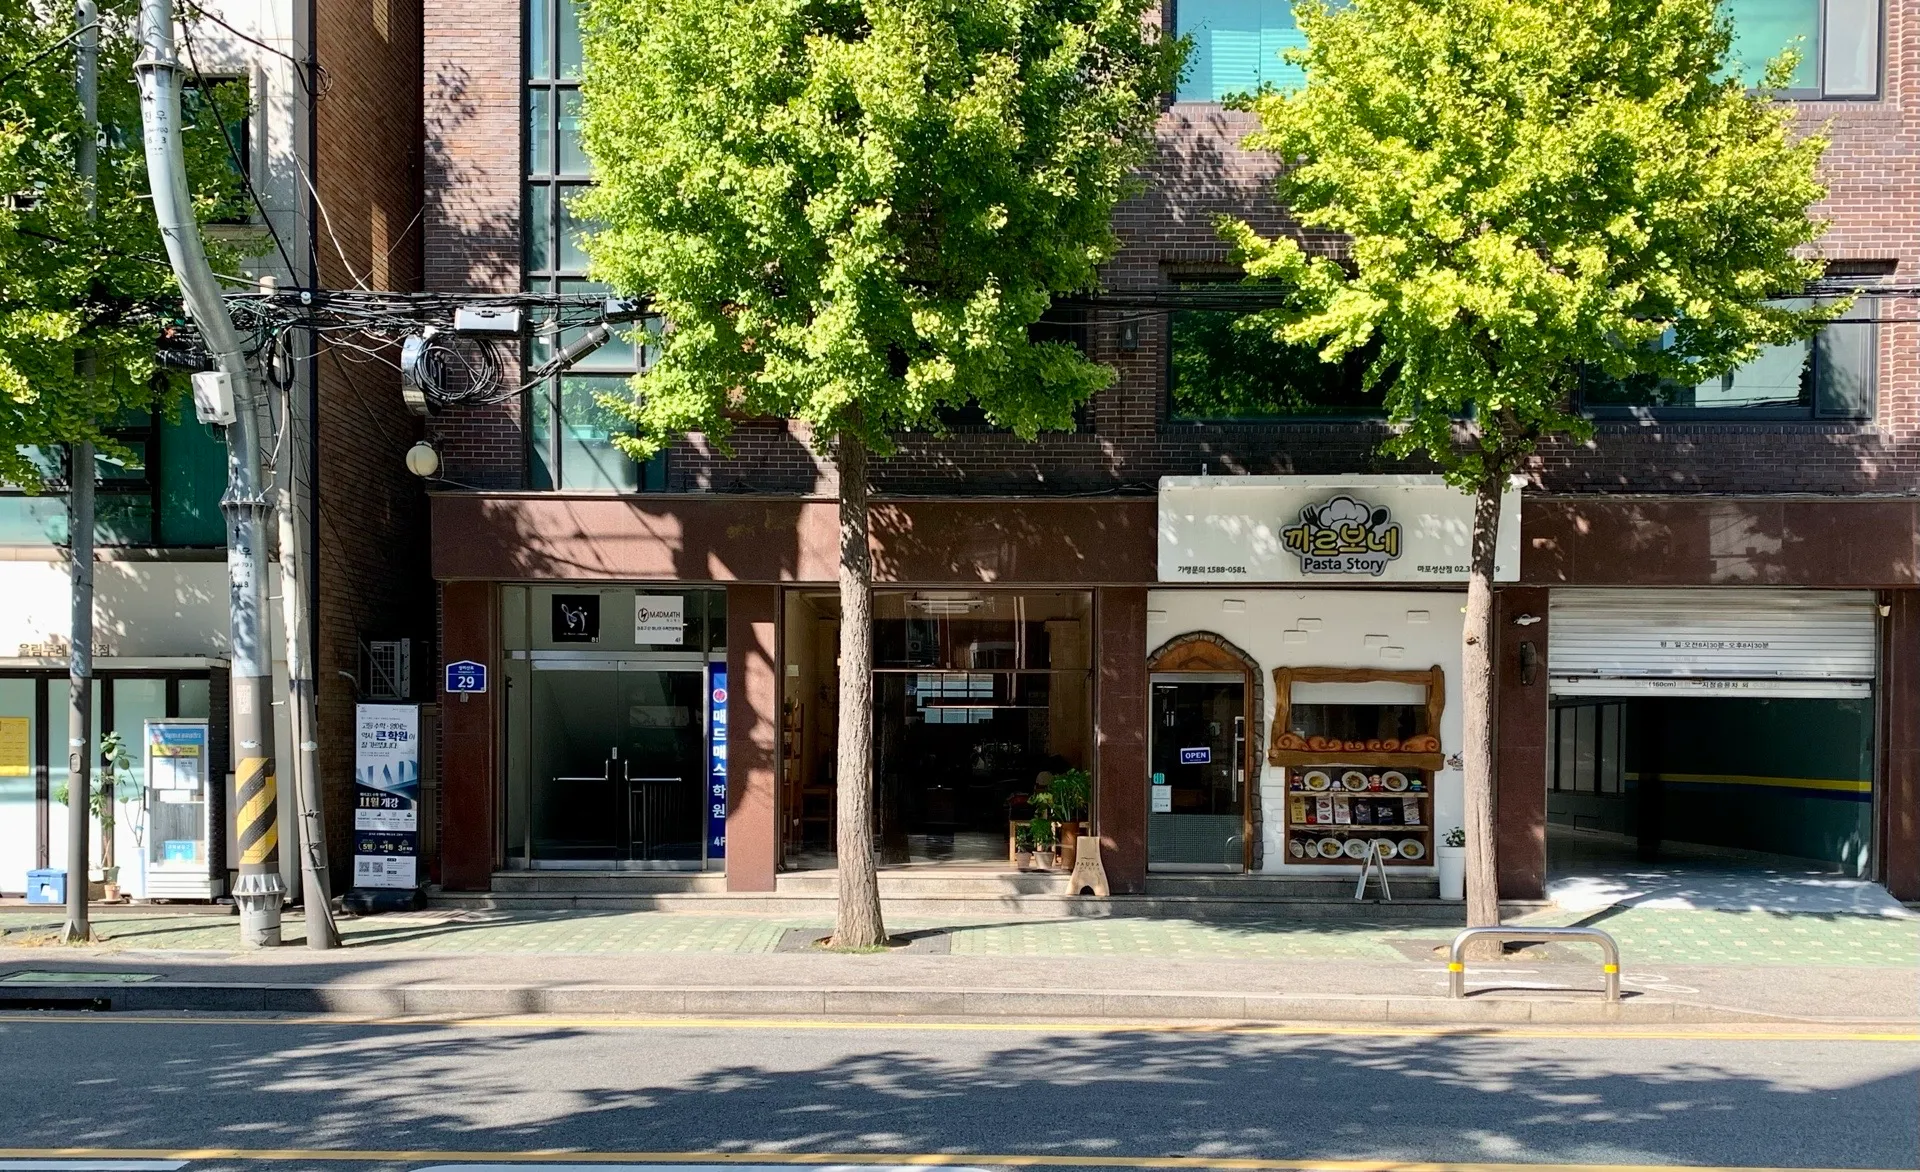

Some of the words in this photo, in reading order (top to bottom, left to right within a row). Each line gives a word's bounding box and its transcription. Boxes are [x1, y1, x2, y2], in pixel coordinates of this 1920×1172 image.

[1283, 523, 1399, 556] 까르보네
[1177, 566, 1206, 574] 가맹문의
[1207, 566, 1245, 574] 1588-0581
[1304, 558, 1342, 570] Pasta
[1347, 558, 1385, 573] Story
[1417, 565, 1453, 574] 마포성산점
[457, 676, 475, 688] 29
[360, 797, 379, 808] 11월
[381, 797, 399, 808] 개강
